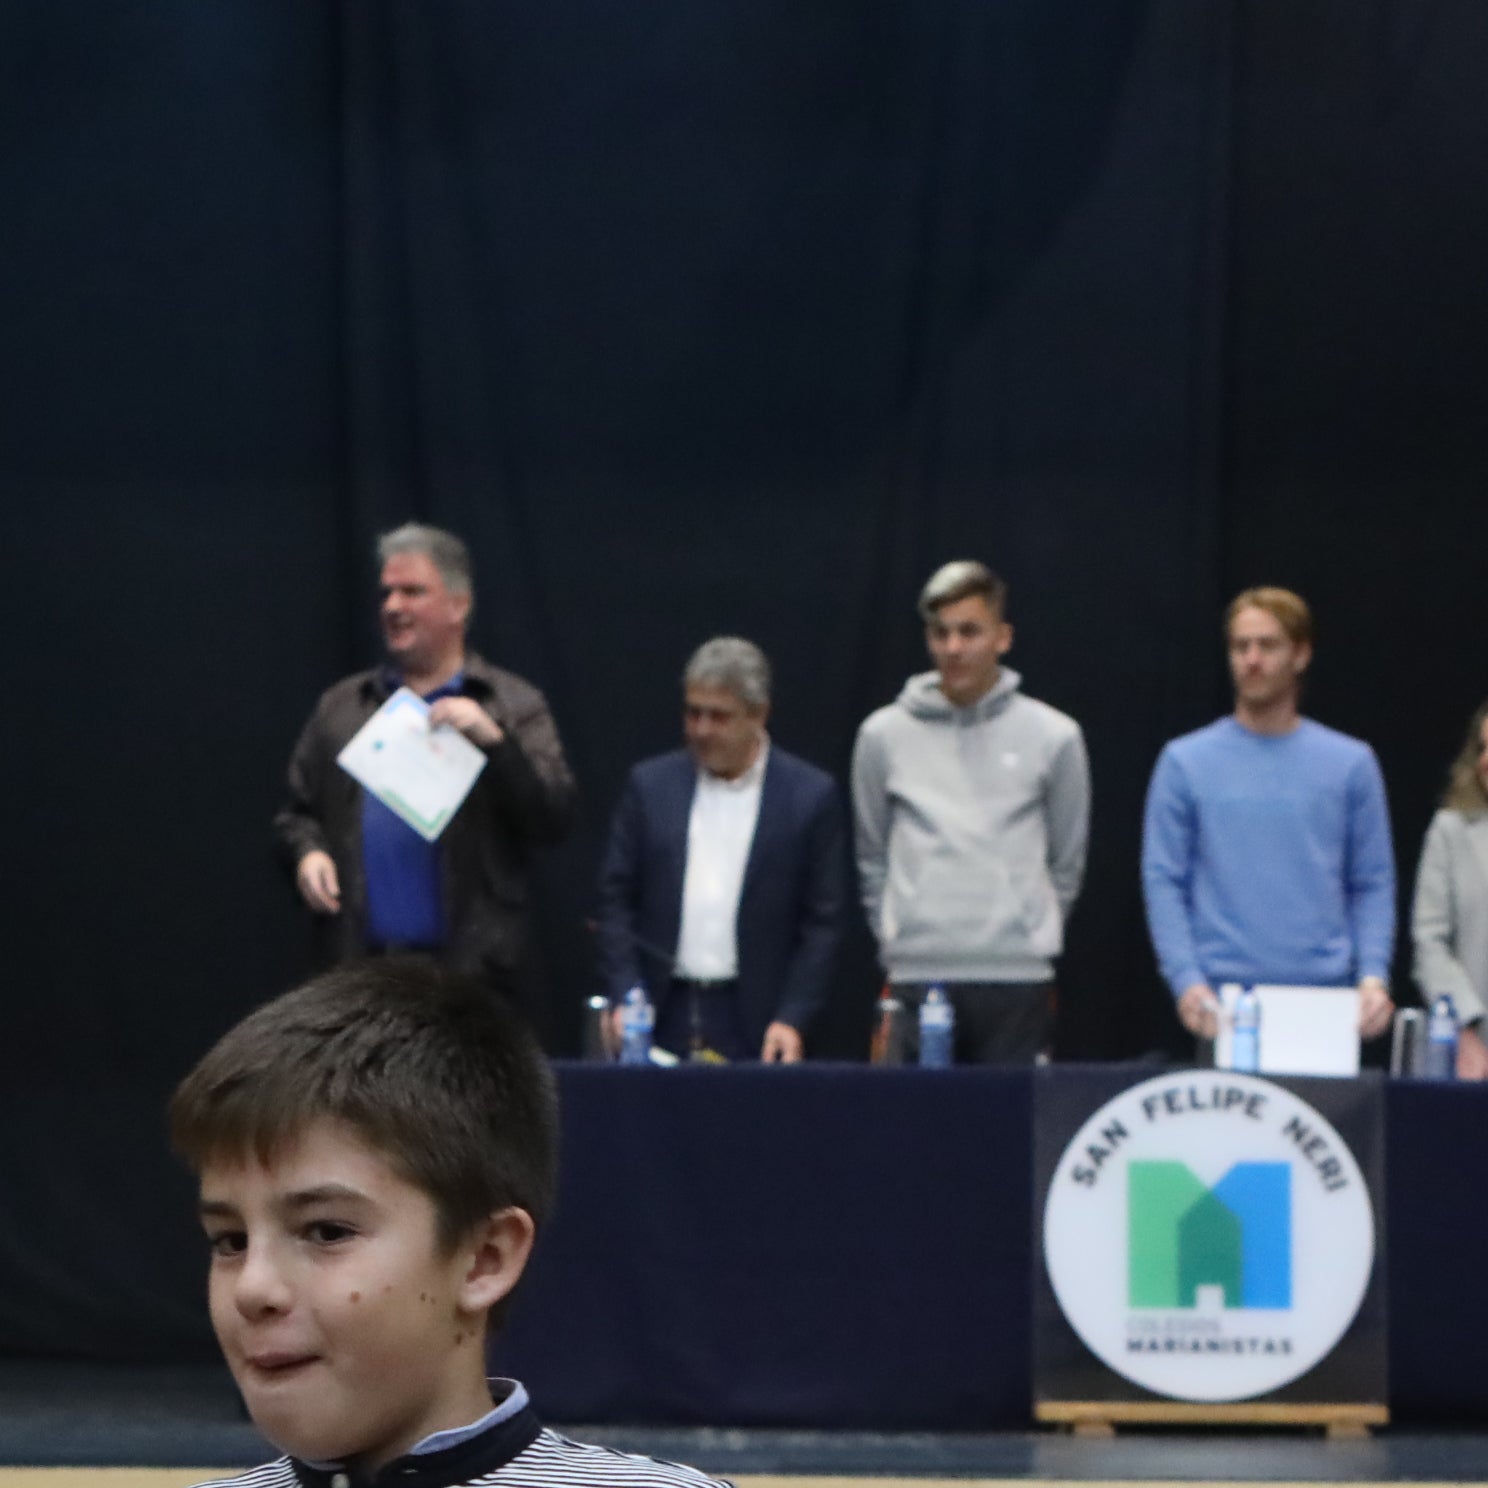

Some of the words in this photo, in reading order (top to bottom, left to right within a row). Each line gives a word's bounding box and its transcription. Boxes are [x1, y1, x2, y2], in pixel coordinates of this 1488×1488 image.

[1071, 1117, 1129, 1188] SAN
[1140, 1085, 1266, 1122] FELIPE
[1281, 1115, 1349, 1193] NERI
[1127, 1337, 1293, 1354] MARIANISTAS
